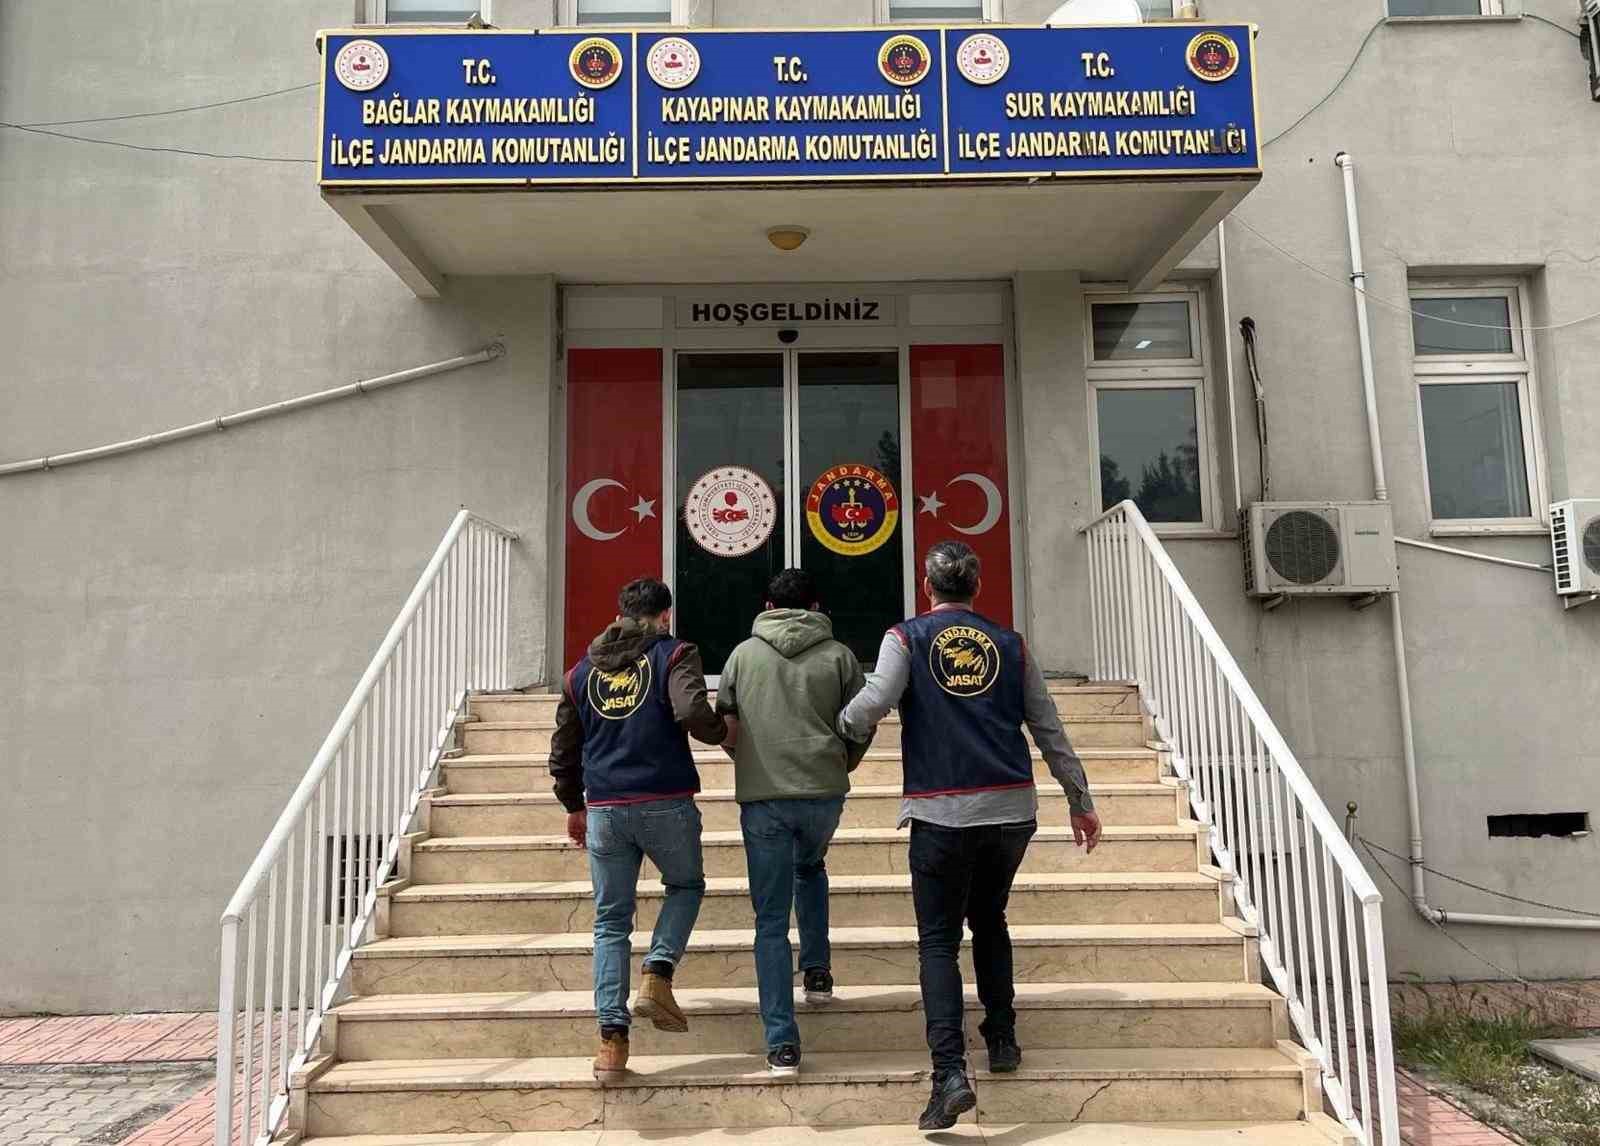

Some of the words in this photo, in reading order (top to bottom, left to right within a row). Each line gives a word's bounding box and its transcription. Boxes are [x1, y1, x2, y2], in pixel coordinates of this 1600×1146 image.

[463, 59, 496, 84] T.C.
[774, 56, 808, 82] T.C.
[1081, 52, 1115, 78] T.C.
[363, 91, 440, 125] BAĞLAR
[446, 91, 594, 124] KAYMAKAMLIĞI
[662, 96, 769, 122] KAYAPINAR
[775, 88, 921, 120] KAYMAKAMLIĞI
[1006, 92, 1045, 118] SUR
[1050, 84, 1196, 117] KAYMAKAMLIĞI
[331, 133, 373, 167] İLÇE
[378, 138, 486, 164] JANDARMA
[492, 130, 625, 164] KOMUTANLIĞI
[647, 131, 690, 165] İLÇE
[695, 135, 800, 162] JANDARMA
[806, 127, 937, 161] KOMUTANLIĞI
[1007, 131, 1111, 158] JANDARMA
[692, 298, 879, 326] HOŞGELDİNİZ
[812, 466, 893, 502] JANDARMA
[936, 628, 992, 650] JANDARMA
[947, 674, 984, 687] JASAT
[602, 694, 637, 711] JASAT
